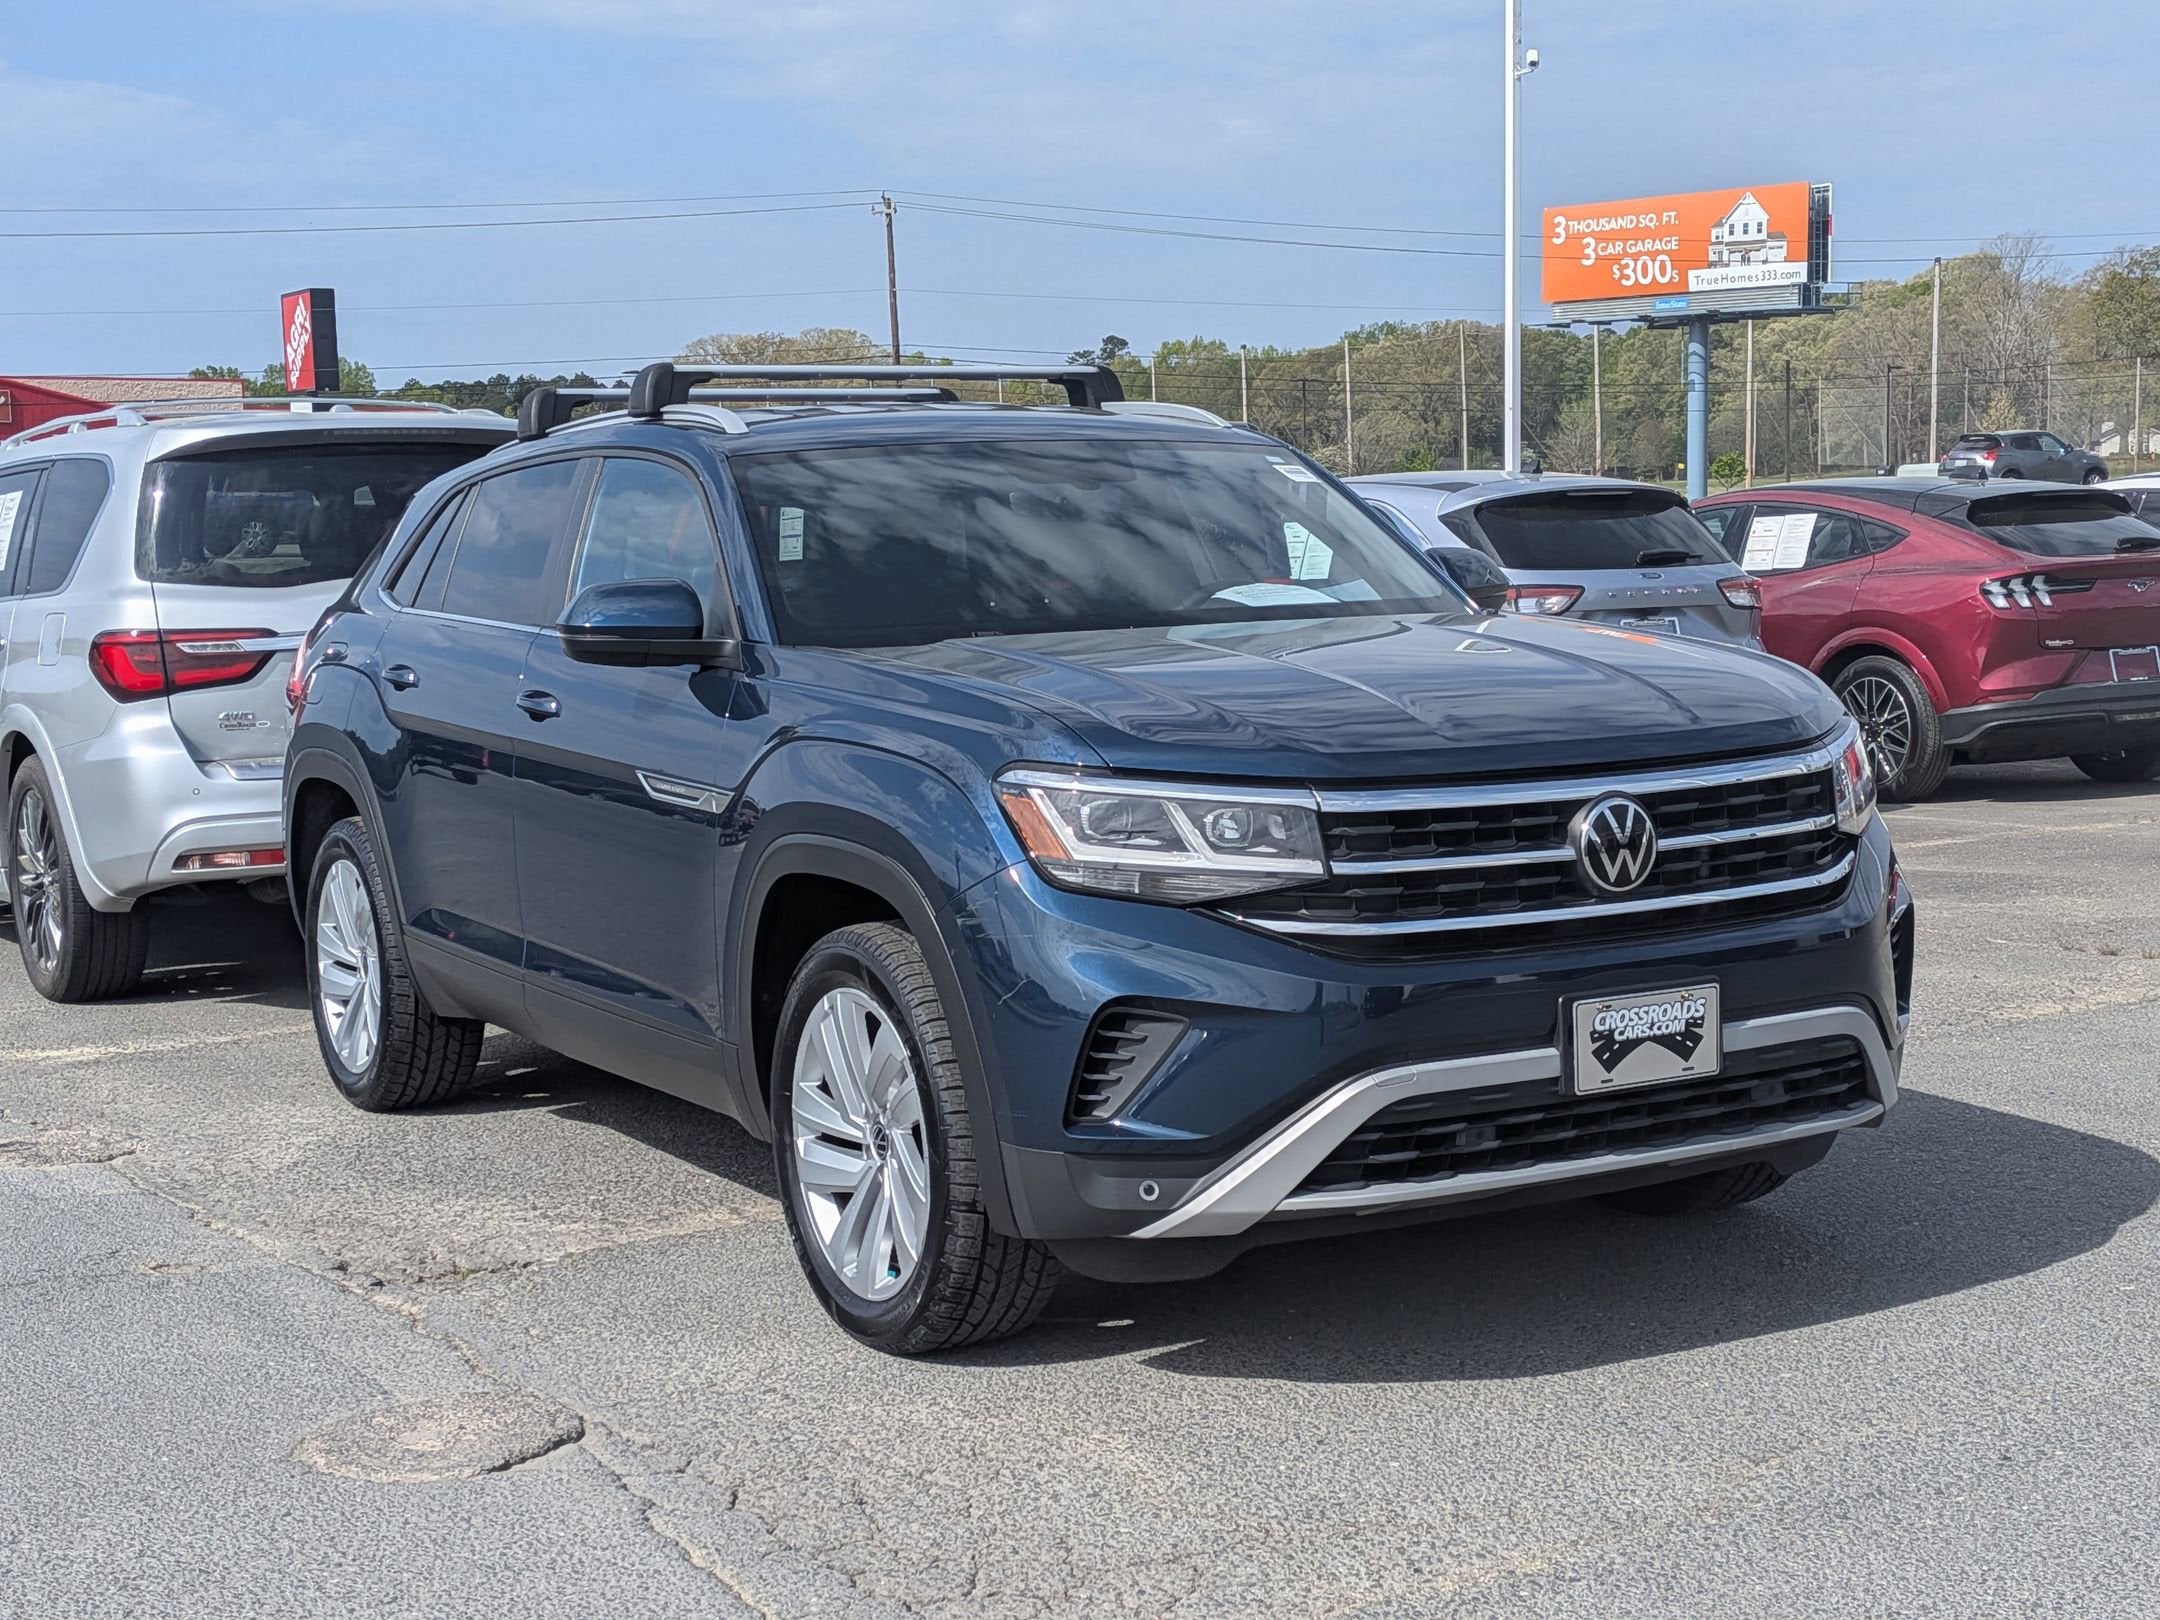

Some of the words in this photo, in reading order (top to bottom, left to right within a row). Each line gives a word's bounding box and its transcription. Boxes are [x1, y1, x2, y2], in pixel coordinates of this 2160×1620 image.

[1552, 215, 1566, 245] 3
[1568, 215, 1637, 234] THOUSAND
[1638, 214, 1659, 228] SQ.
[1662, 211, 1679, 226] FT.
[1581, 237, 1595, 266] 3
[1597, 241, 1624, 257] CAR
[1626, 236, 1680, 253] GARAGE
[1694, 270, 1801, 287] TrueHomes333.com
[1593, 997, 1707, 1031] CROSSROADS
[1613, 1019, 1686, 1042] CARS.COM
